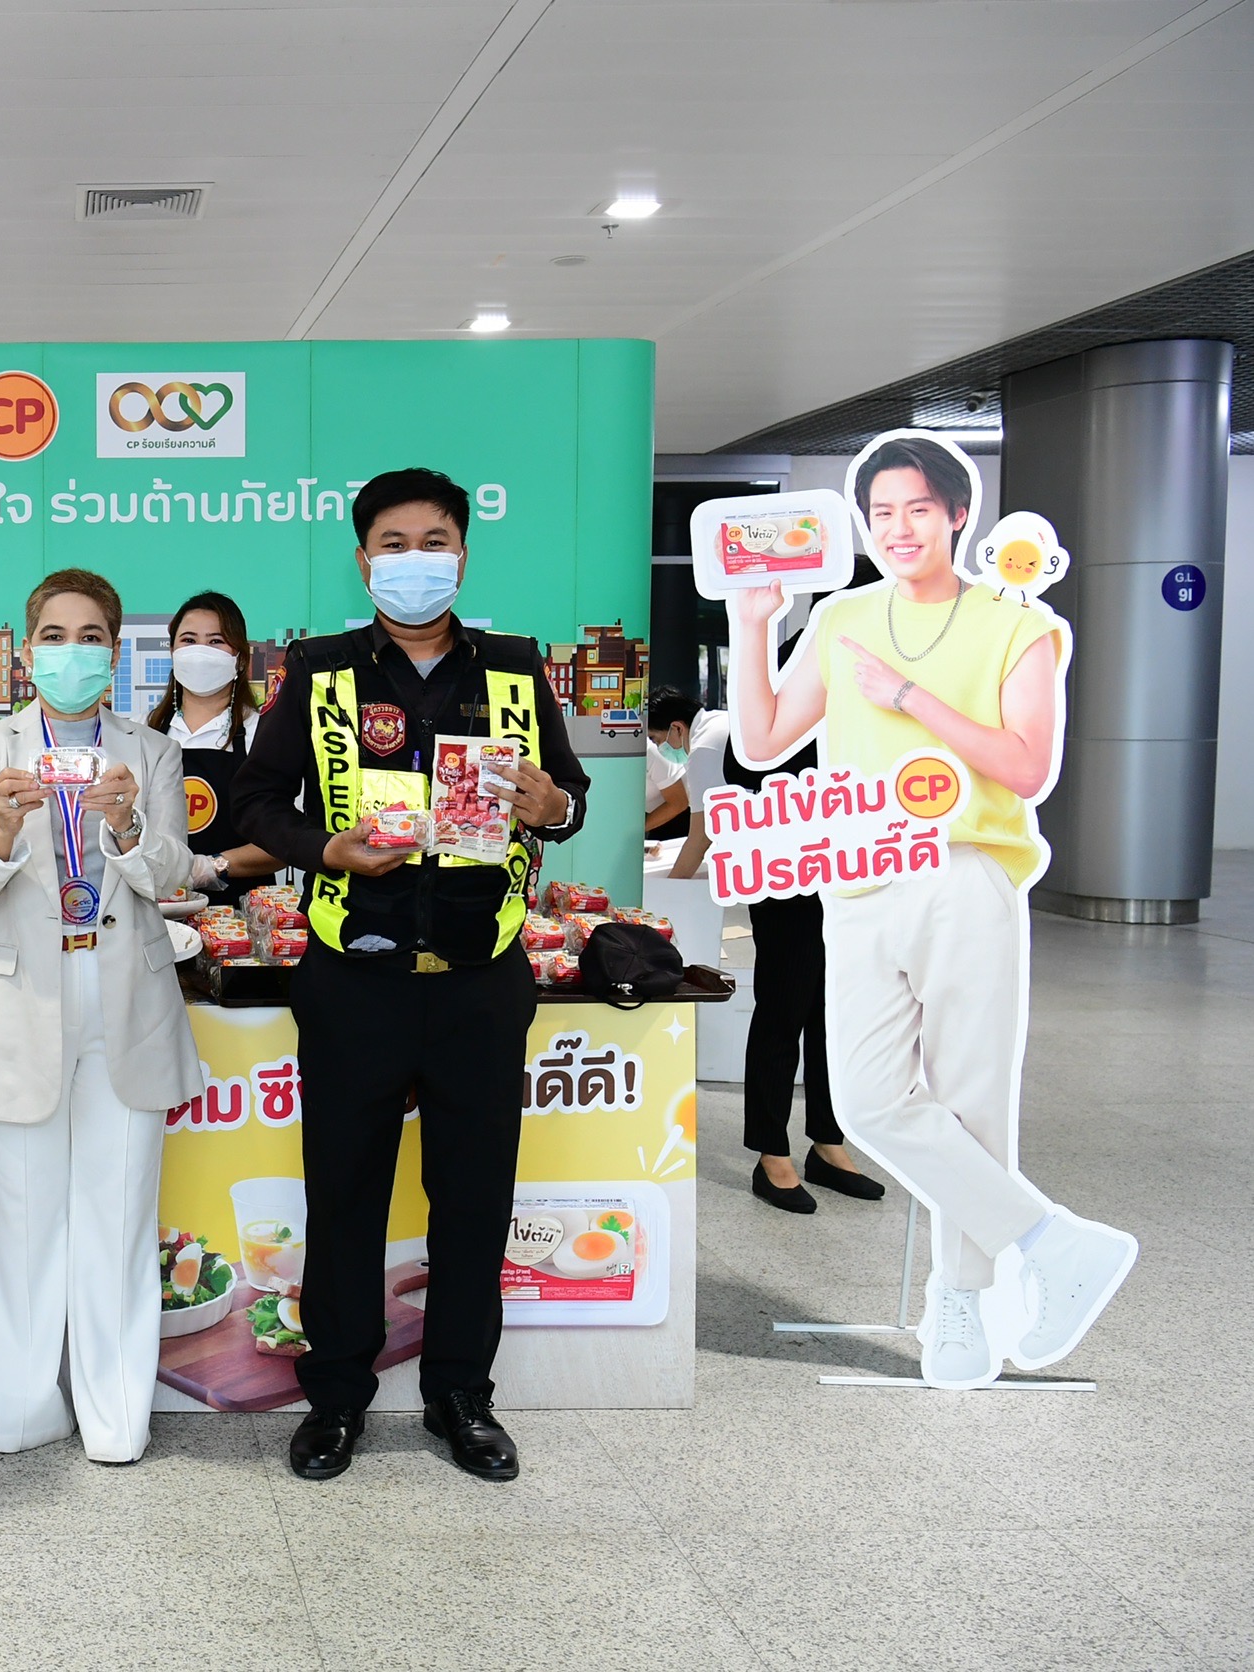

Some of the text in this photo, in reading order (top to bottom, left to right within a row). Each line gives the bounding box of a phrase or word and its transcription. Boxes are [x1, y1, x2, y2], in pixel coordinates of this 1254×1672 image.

[127, 438, 216, 449] CP ร้อยเรียงความดี
[729, 530, 741, 538] CP
[709, 770, 887, 835] กินไข่ต้ม
[903, 774, 952, 803] CP
[711, 820, 940, 898] โปรตีนดี๊ดี
